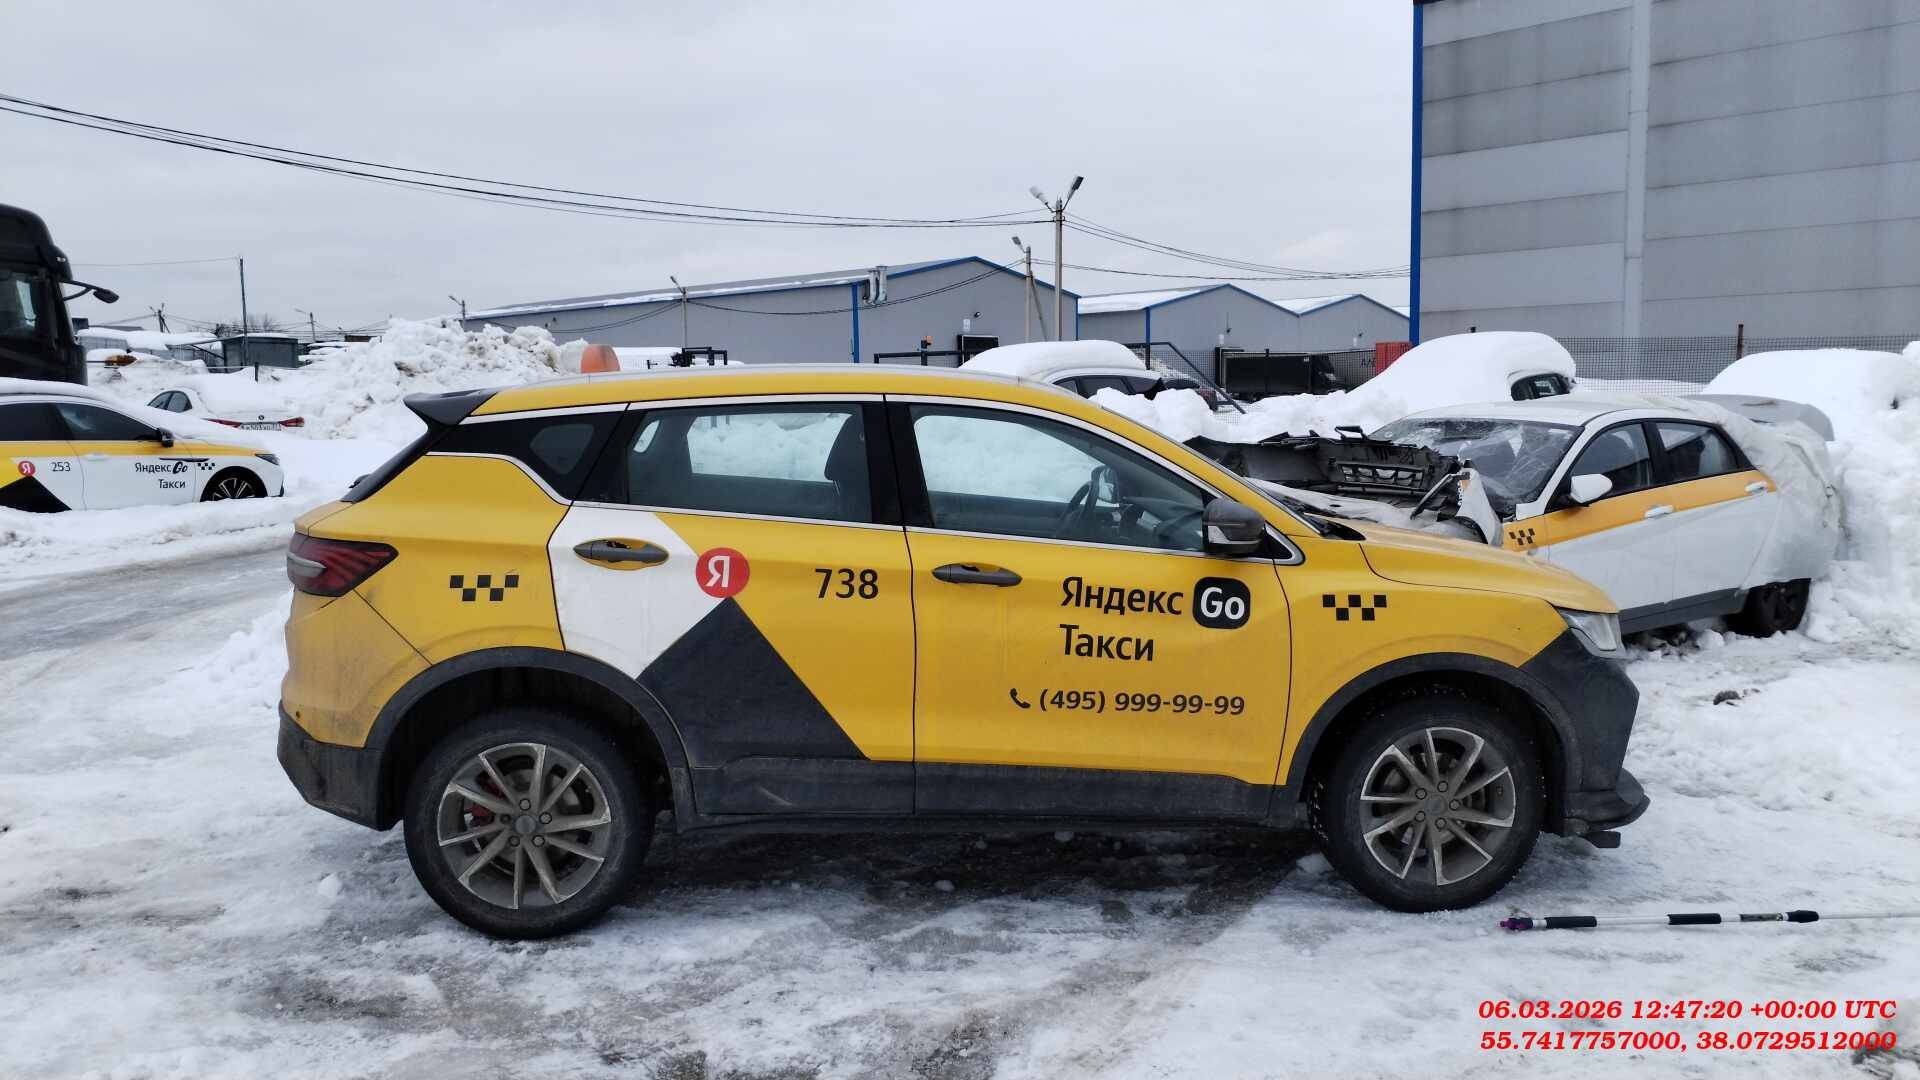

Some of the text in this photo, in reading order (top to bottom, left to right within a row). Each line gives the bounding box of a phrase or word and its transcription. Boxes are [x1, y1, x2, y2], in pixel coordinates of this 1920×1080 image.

[52, 462, 71, 472] 253
[135, 462, 188, 474] Яндекс Go
[158, 479, 186, 489] Такси
[705, 555, 730, 588] Я
[815, 568, 879, 600] 738
[1061, 576, 1245, 620] Яндекс Go
[1059, 623, 1154, 662] Такси
[1039, 688, 1246, 716] (495) 999-99-99
